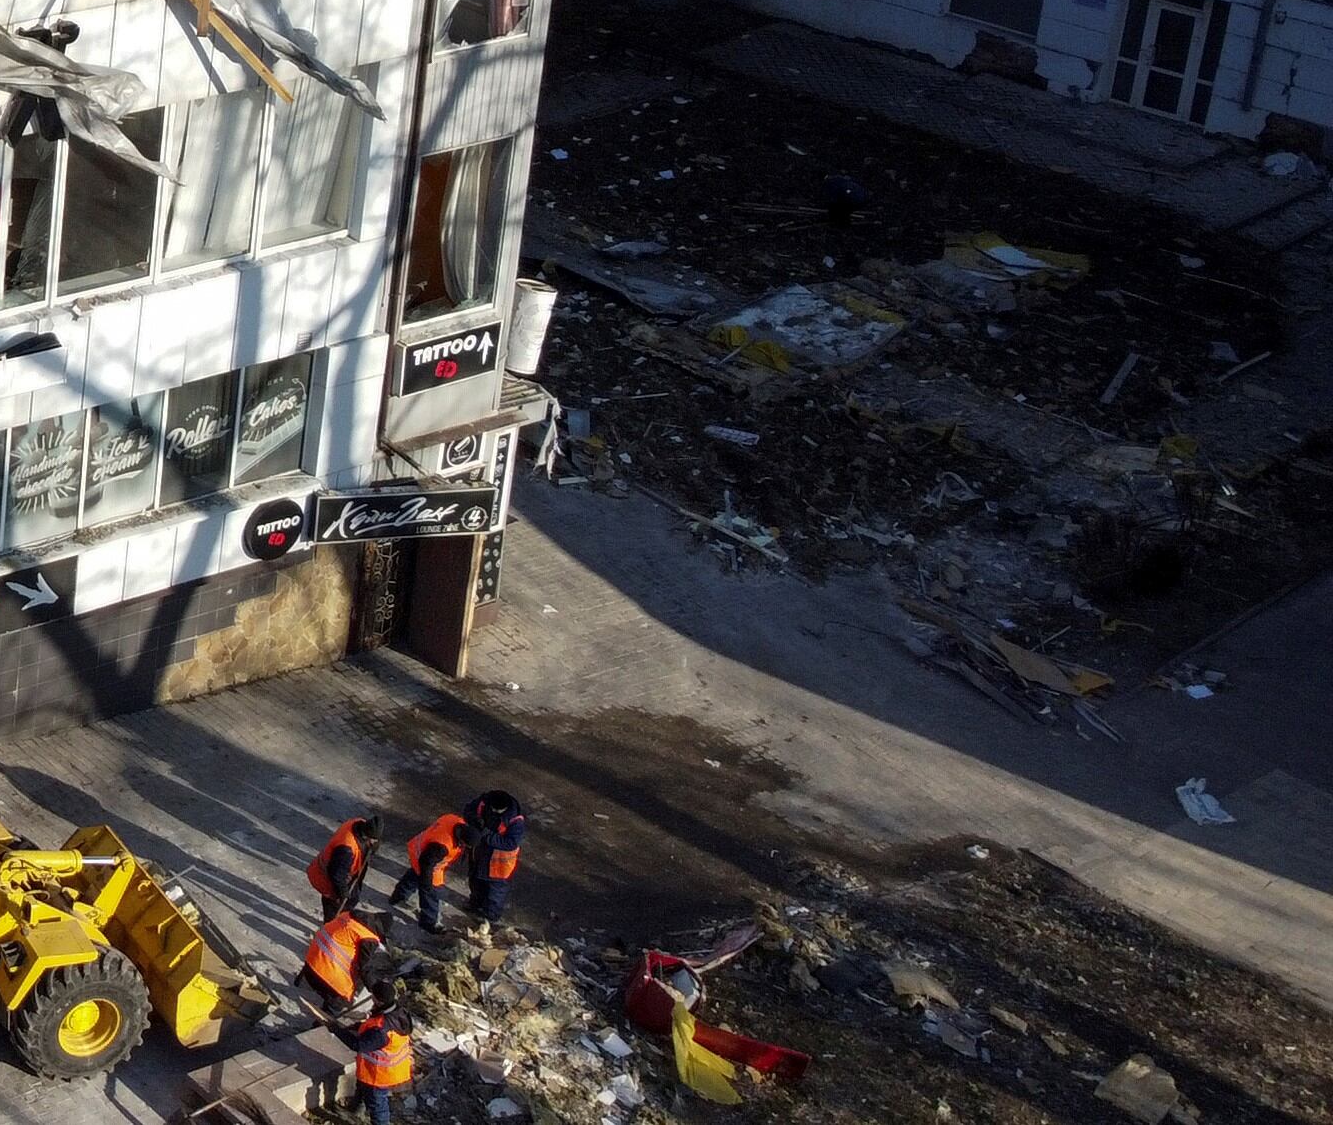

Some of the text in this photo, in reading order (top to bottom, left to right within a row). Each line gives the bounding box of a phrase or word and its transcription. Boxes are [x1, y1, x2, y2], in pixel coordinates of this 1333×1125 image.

[412, 334, 478, 367] TATTOO
[435, 359, 459, 379] ED
[256, 514, 301, 537] TATTOO
[267, 531, 287, 546] ED
